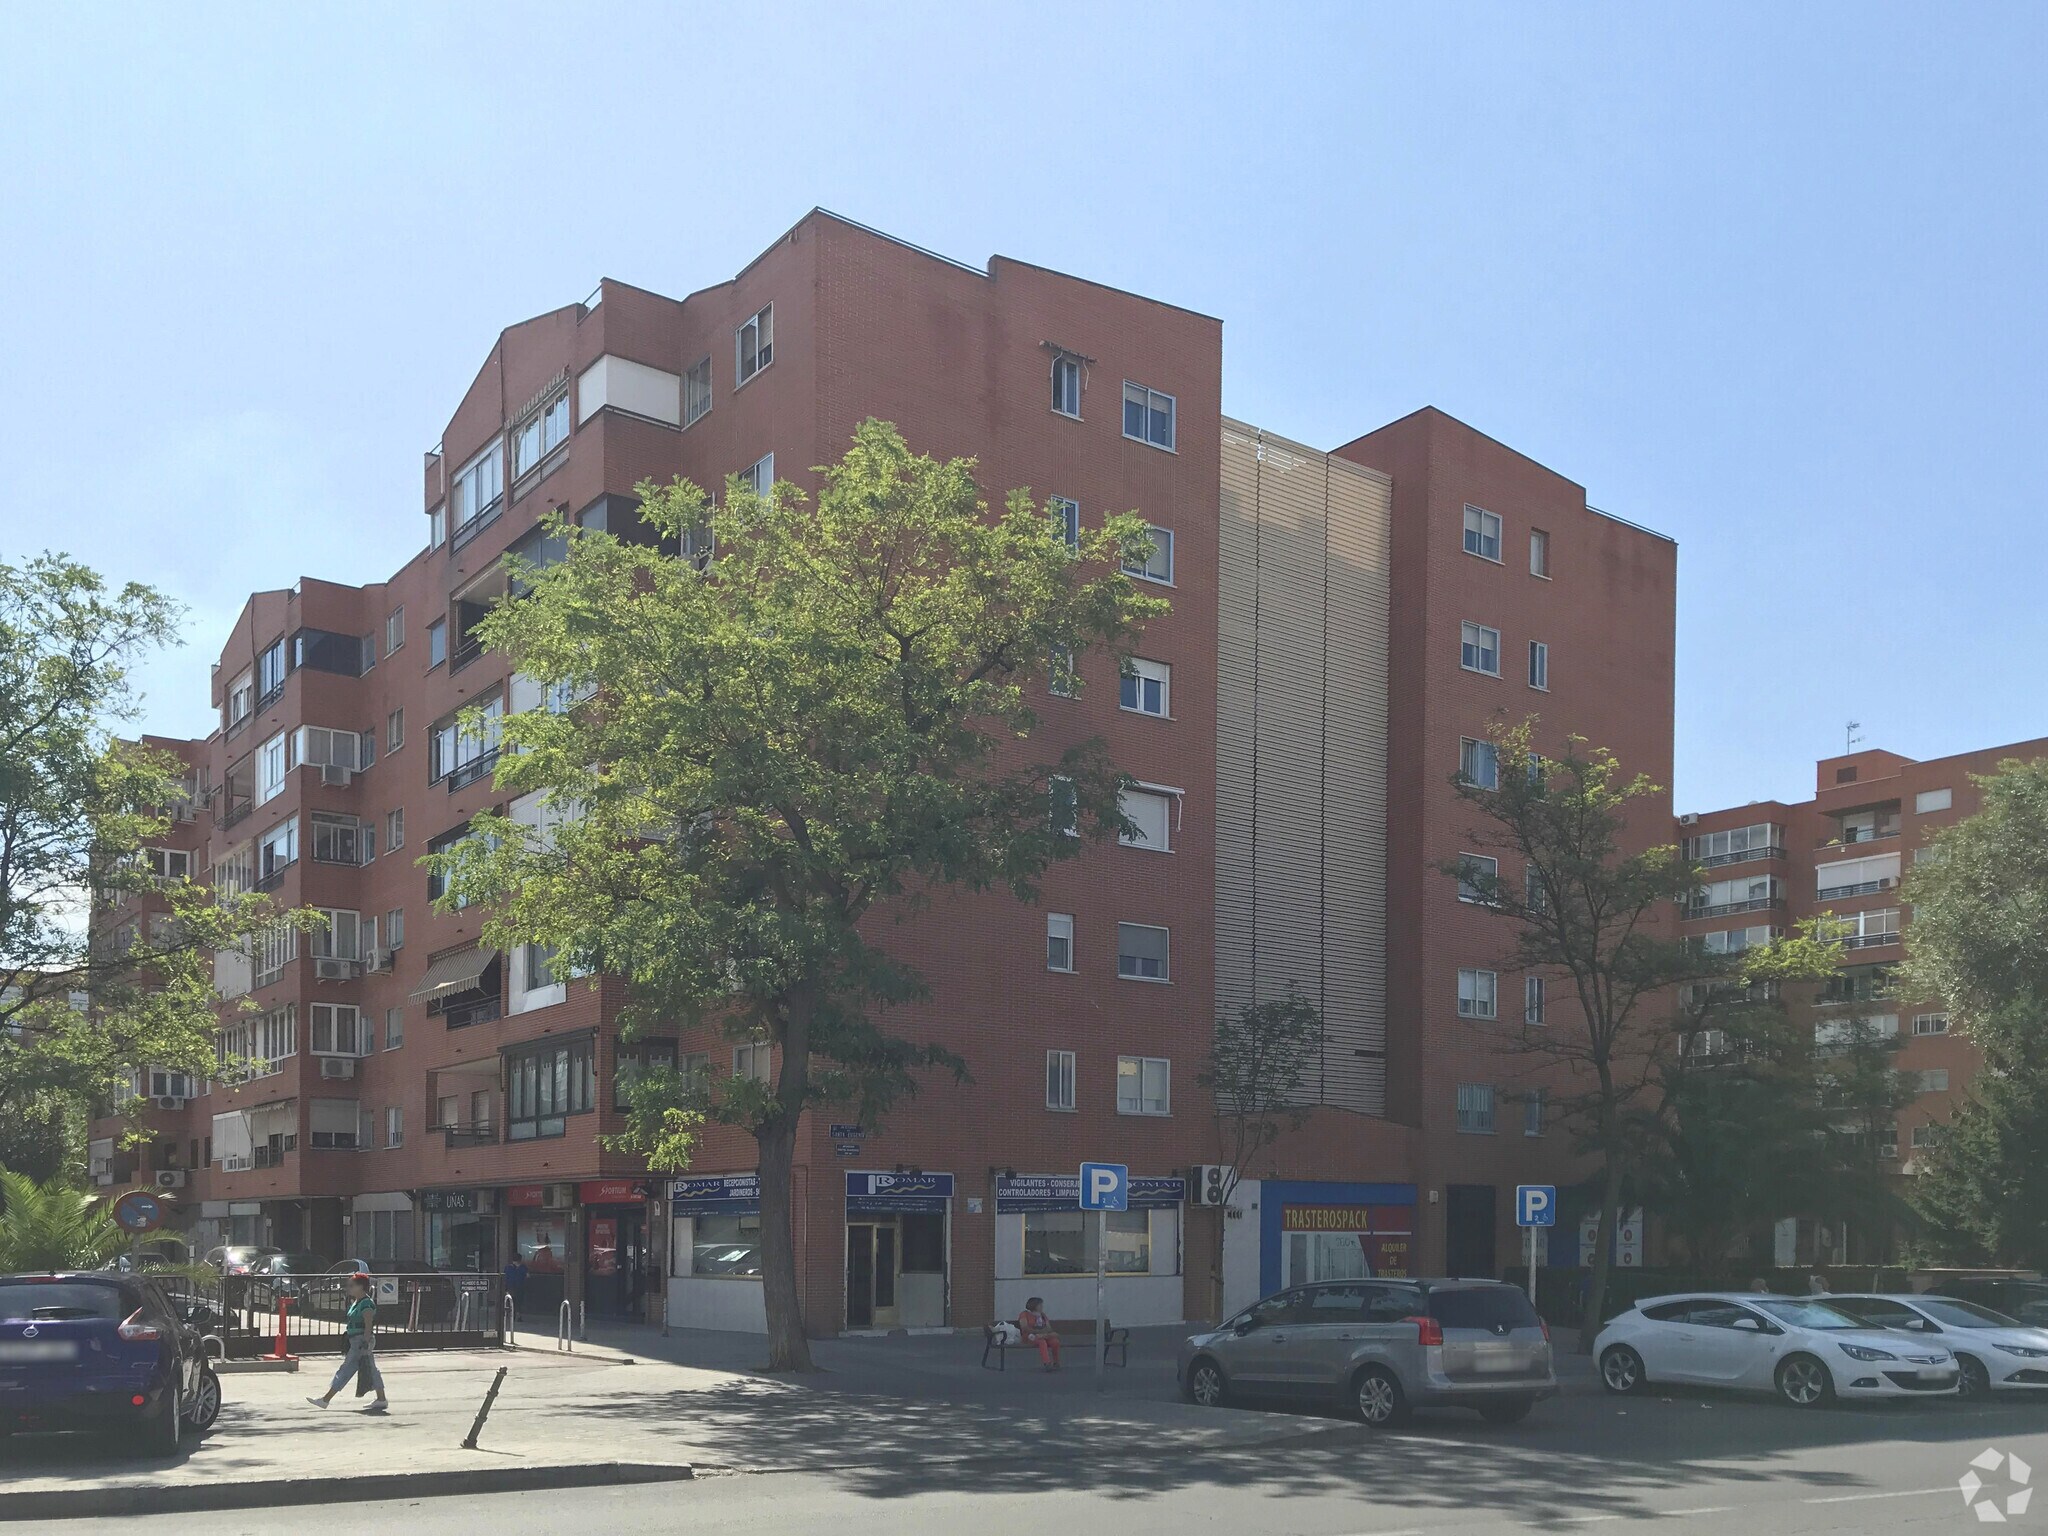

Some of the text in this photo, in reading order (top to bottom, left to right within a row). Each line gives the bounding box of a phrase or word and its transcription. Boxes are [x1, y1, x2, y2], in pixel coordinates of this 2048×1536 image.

[674, 1181, 720, 1192] ROMAR
[877, 1175, 936, 1187] ROMAR
[1091, 1169, 1118, 1204] P
[446, 1192, 465, 1208] UÑAS
[1526, 1190, 1548, 1221] P
[1285, 1209, 1368, 1228] TRASTEROSPACK
[1381, 1242, 1407, 1252] ALQUILER
[1377, 1268, 1407, 1278] TRASTEROS
